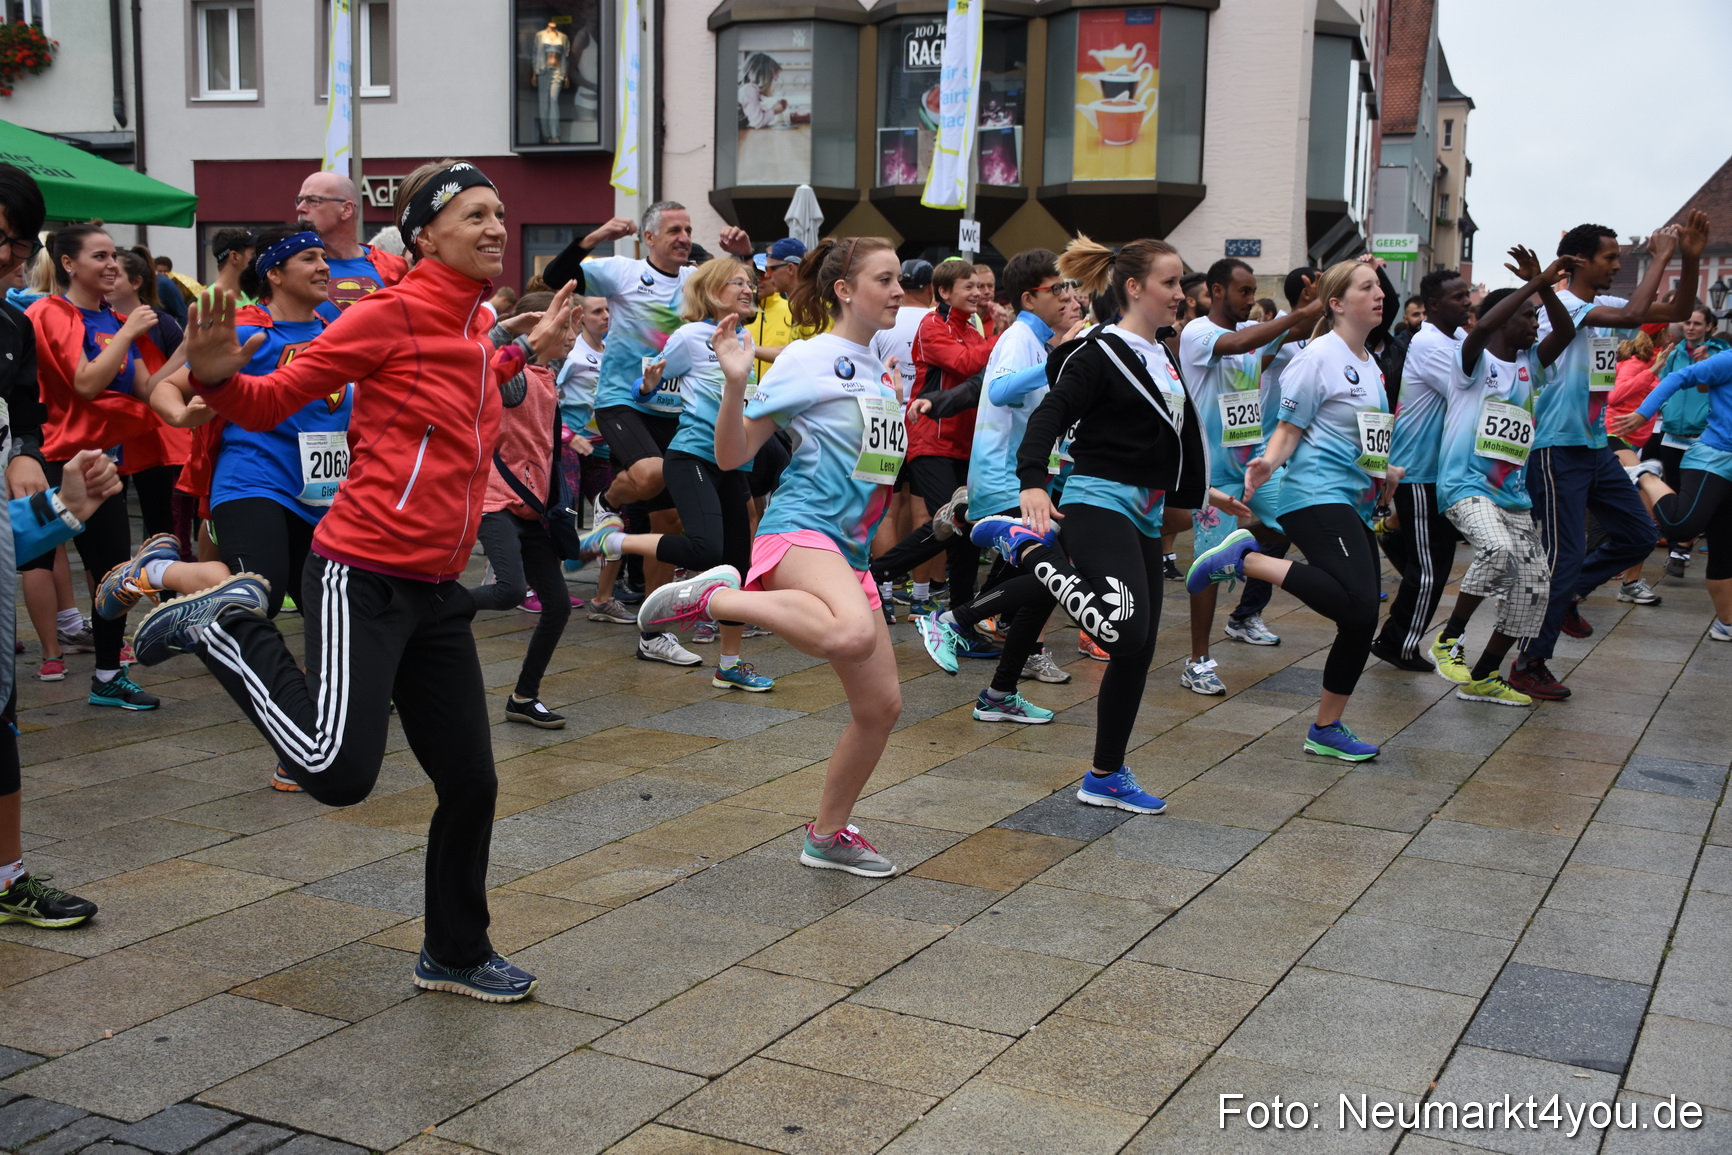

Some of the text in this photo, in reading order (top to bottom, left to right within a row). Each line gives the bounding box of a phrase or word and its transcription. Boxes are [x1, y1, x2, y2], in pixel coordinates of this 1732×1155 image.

[914, 26, 934, 38] 100
[961, 228, 977, 243] WC
[1375, 239, 1408, 248] GEERS
[1595, 350, 1617, 370] 52
[1226, 402, 1261, 426] 5239
[869, 416, 904, 453] 5142
[1485, 415, 1531, 444] 5238
[1366, 428, 1392, 454] 503
[1482, 440, 1524, 457] Mohammad
[309, 449, 348, 479] 2063
[879, 458, 895, 473] Lena
[1034, 561, 1119, 643] adidas
